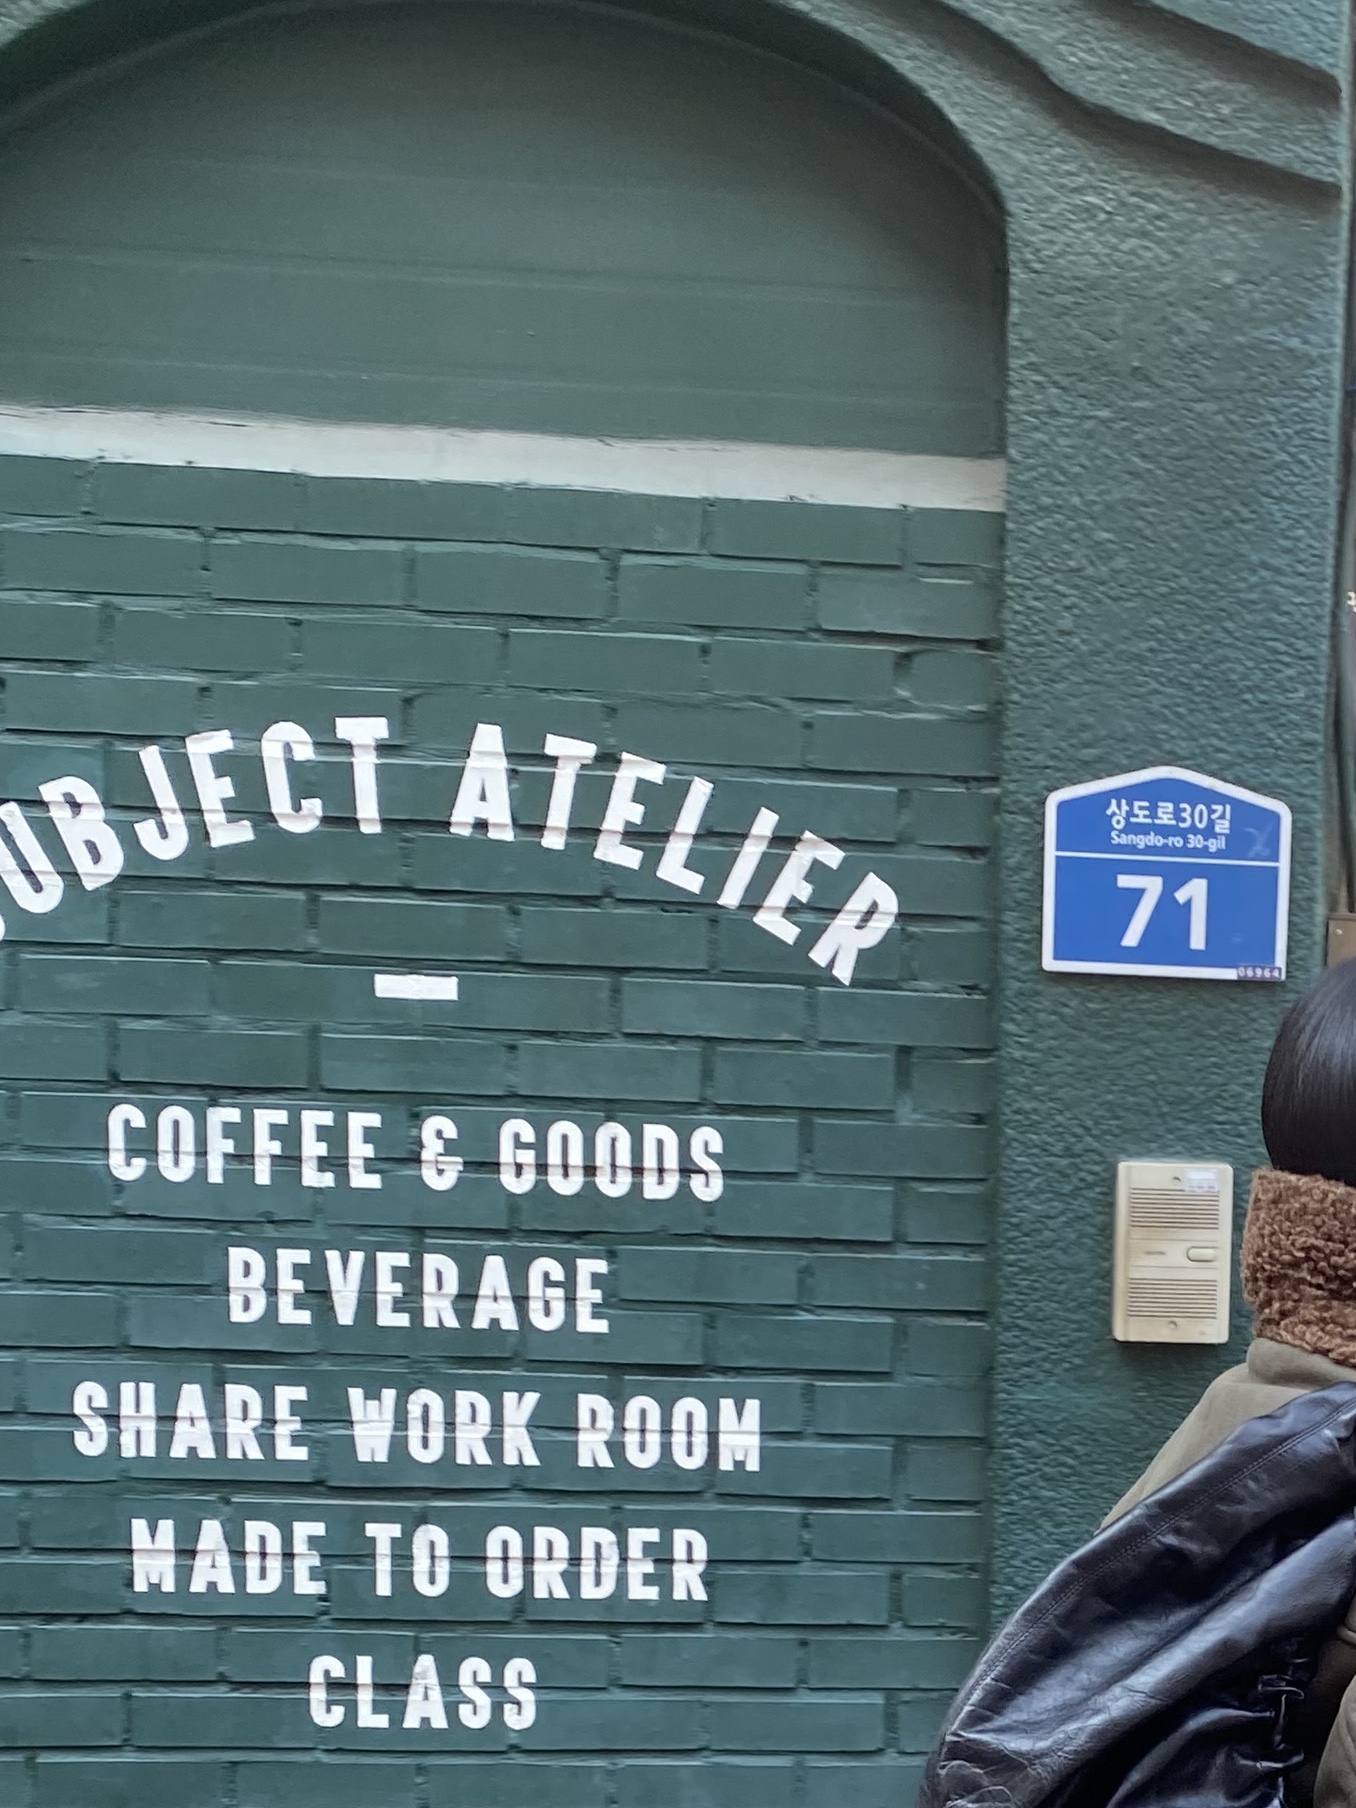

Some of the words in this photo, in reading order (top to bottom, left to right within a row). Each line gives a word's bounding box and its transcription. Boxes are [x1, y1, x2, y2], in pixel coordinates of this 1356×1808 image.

[0, 716, 389, 942] UBJECT
[449, 722, 899, 986] ATELIER
[1105, 798, 1232, 834] 상도로30길
[1110, 830, 1184, 850] Sangdo-ro
[1186, 833, 1226, 853] 30-gil
[1116, 874, 1208, 951] 71
[108, 1103, 382, 1189] COFFEE
[420, 1115, 464, 1191] &
[499, 1118, 724, 1202] GOODS
[228, 1246, 609, 1334] BEVERAGE
[73, 1381, 309, 1461] SHARE
[348, 1387, 541, 1467] WORK
[577, 1394, 760, 1472] ROOM
[131, 1518, 327, 1595] MADE
[365, 1523, 450, 1597] TO
[486, 1526, 708, 1601] ORDER
[309, 1654, 537, 1731] CLASS
